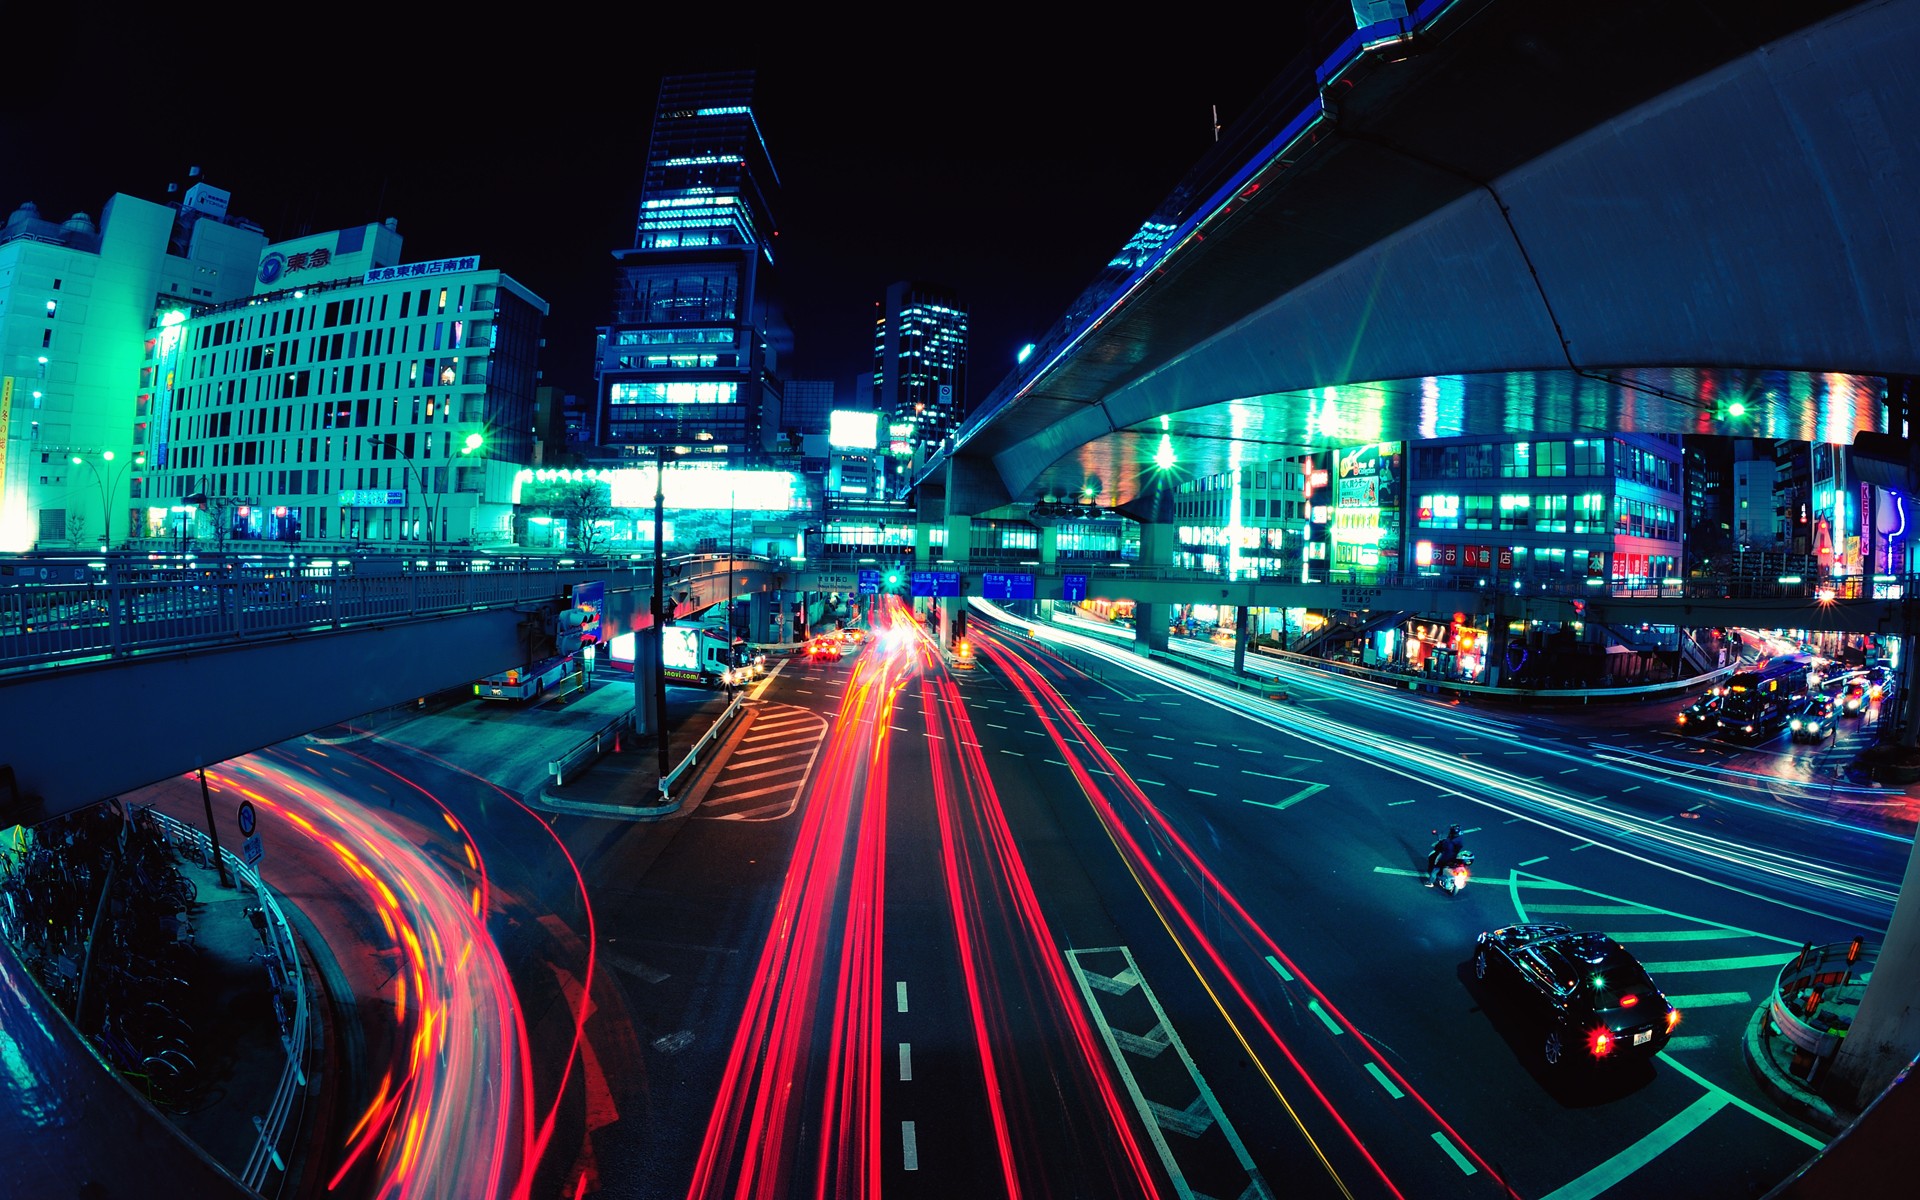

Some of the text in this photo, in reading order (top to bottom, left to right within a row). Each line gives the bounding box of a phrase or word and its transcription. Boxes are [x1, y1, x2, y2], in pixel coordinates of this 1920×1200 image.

[286, 248, 330, 273] 東急
[367, 257, 475, 282] 東急東横店南館
[207, 496, 259, 507] TOKYU
[1432, 549, 1512, 565] あおい書店
[1589, 554, 1603, 573] 本
